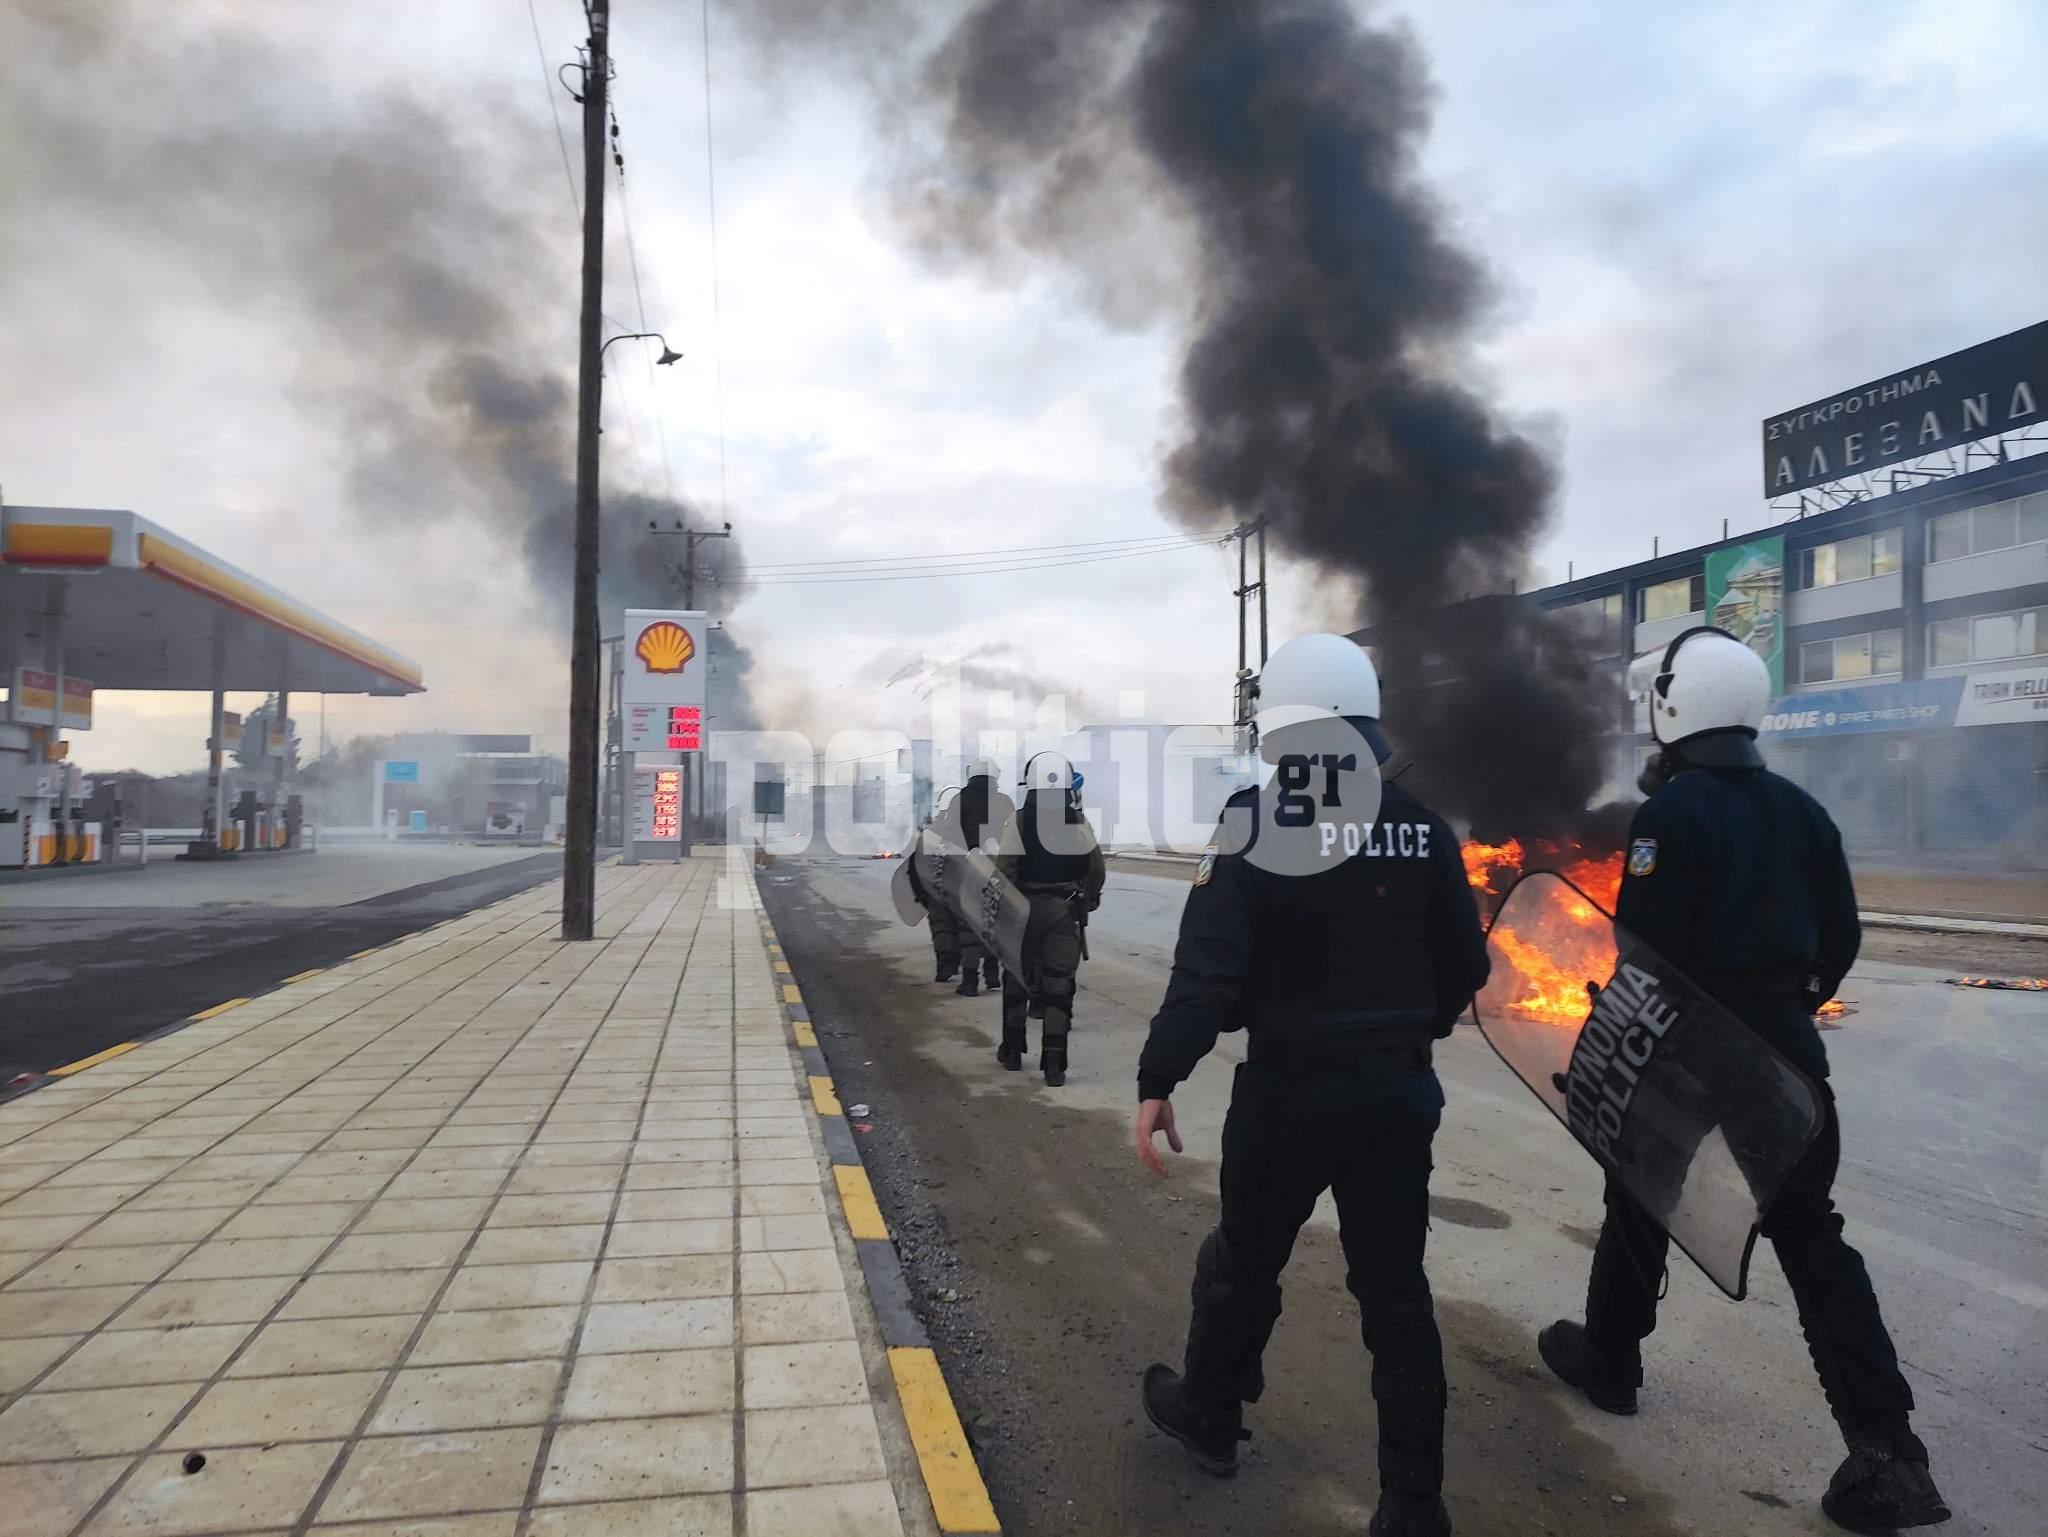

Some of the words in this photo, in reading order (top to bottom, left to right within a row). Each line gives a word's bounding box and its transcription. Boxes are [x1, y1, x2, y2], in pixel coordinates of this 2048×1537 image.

[1767, 369, 1942, 441] ΣΥΓΚΡΟΤΗΜΑ
[1318, 822, 1431, 858] POLICE
[1596, 994, 1679, 1167] POLICE
